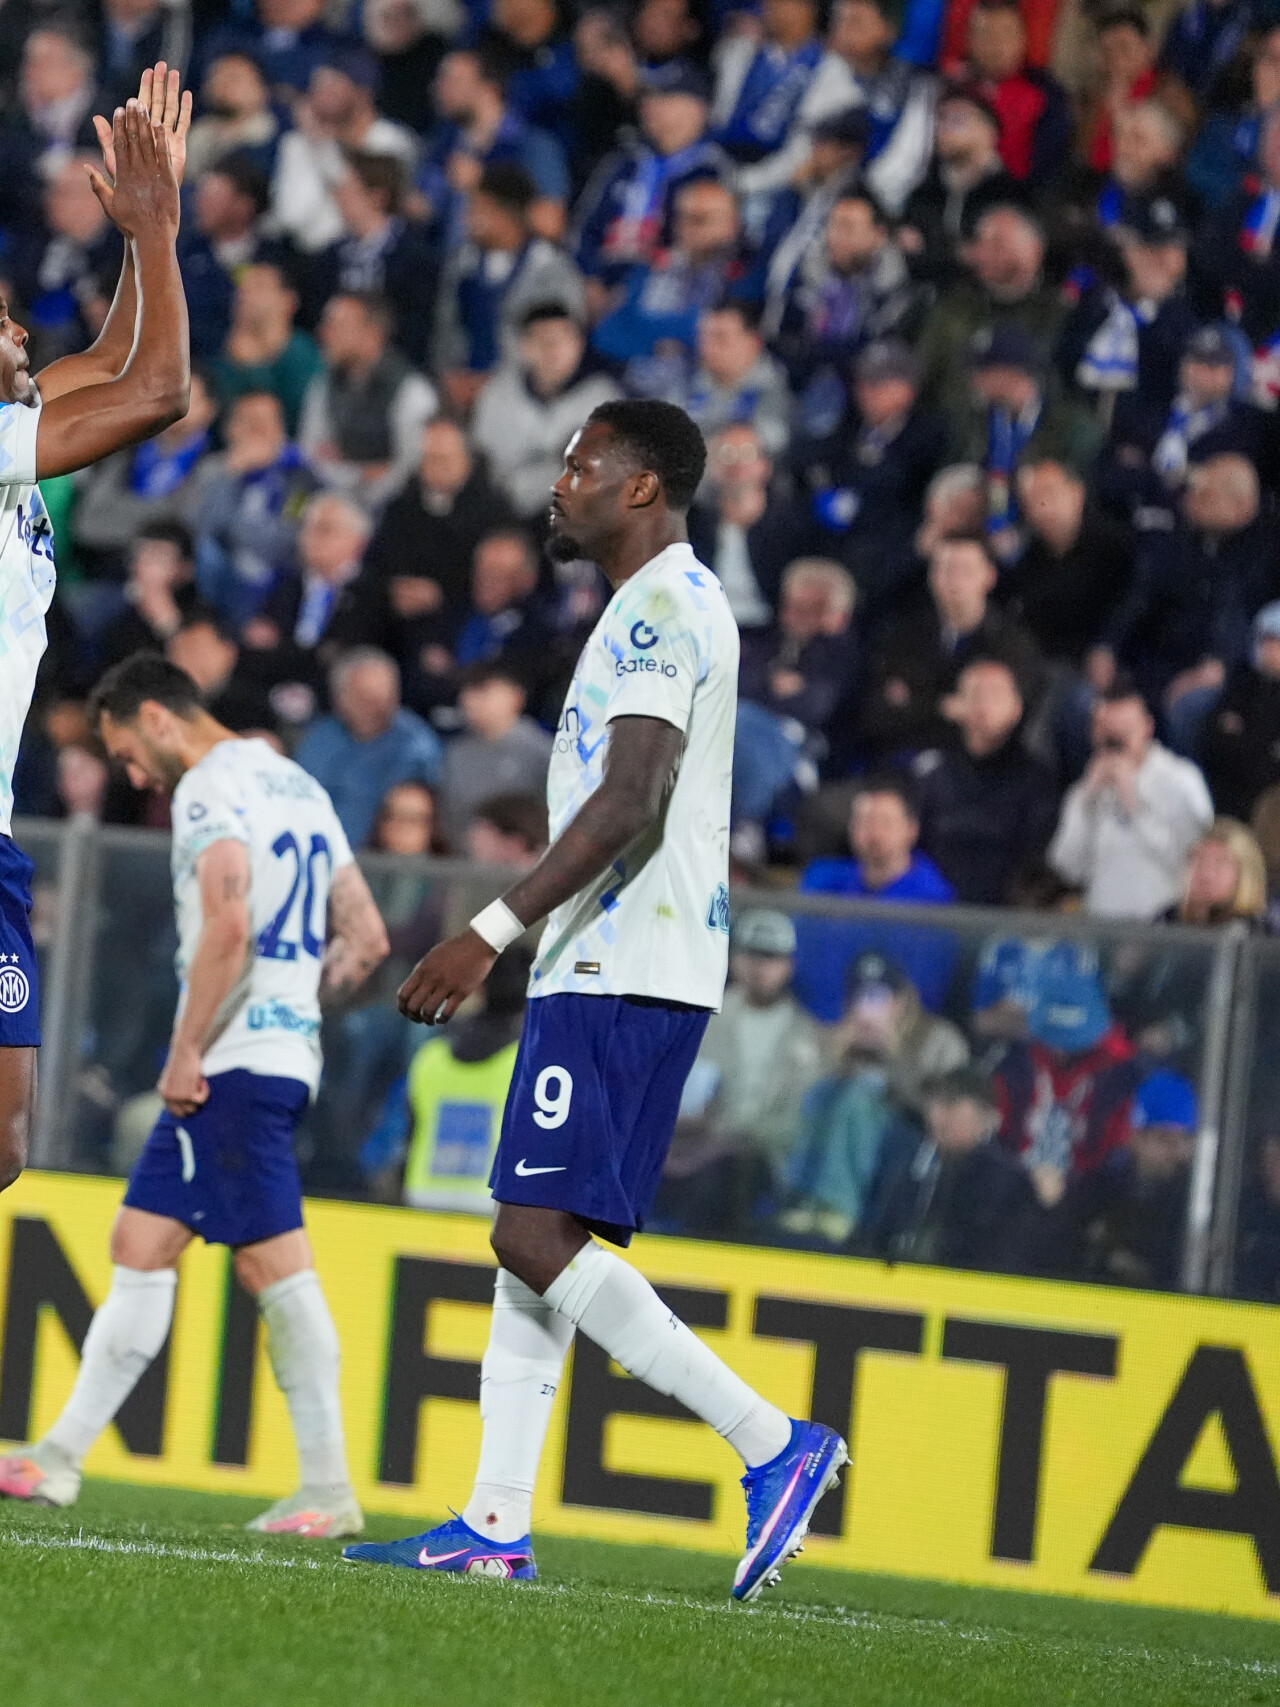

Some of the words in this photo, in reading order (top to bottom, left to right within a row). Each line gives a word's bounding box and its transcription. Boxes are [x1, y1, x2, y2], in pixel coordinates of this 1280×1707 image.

[615, 656, 678, 678] Gate.io
[257, 829, 332, 960] 20
[532, 1065, 573, 1130] 9
[374, 1253, 1280, 1598] FETTA
